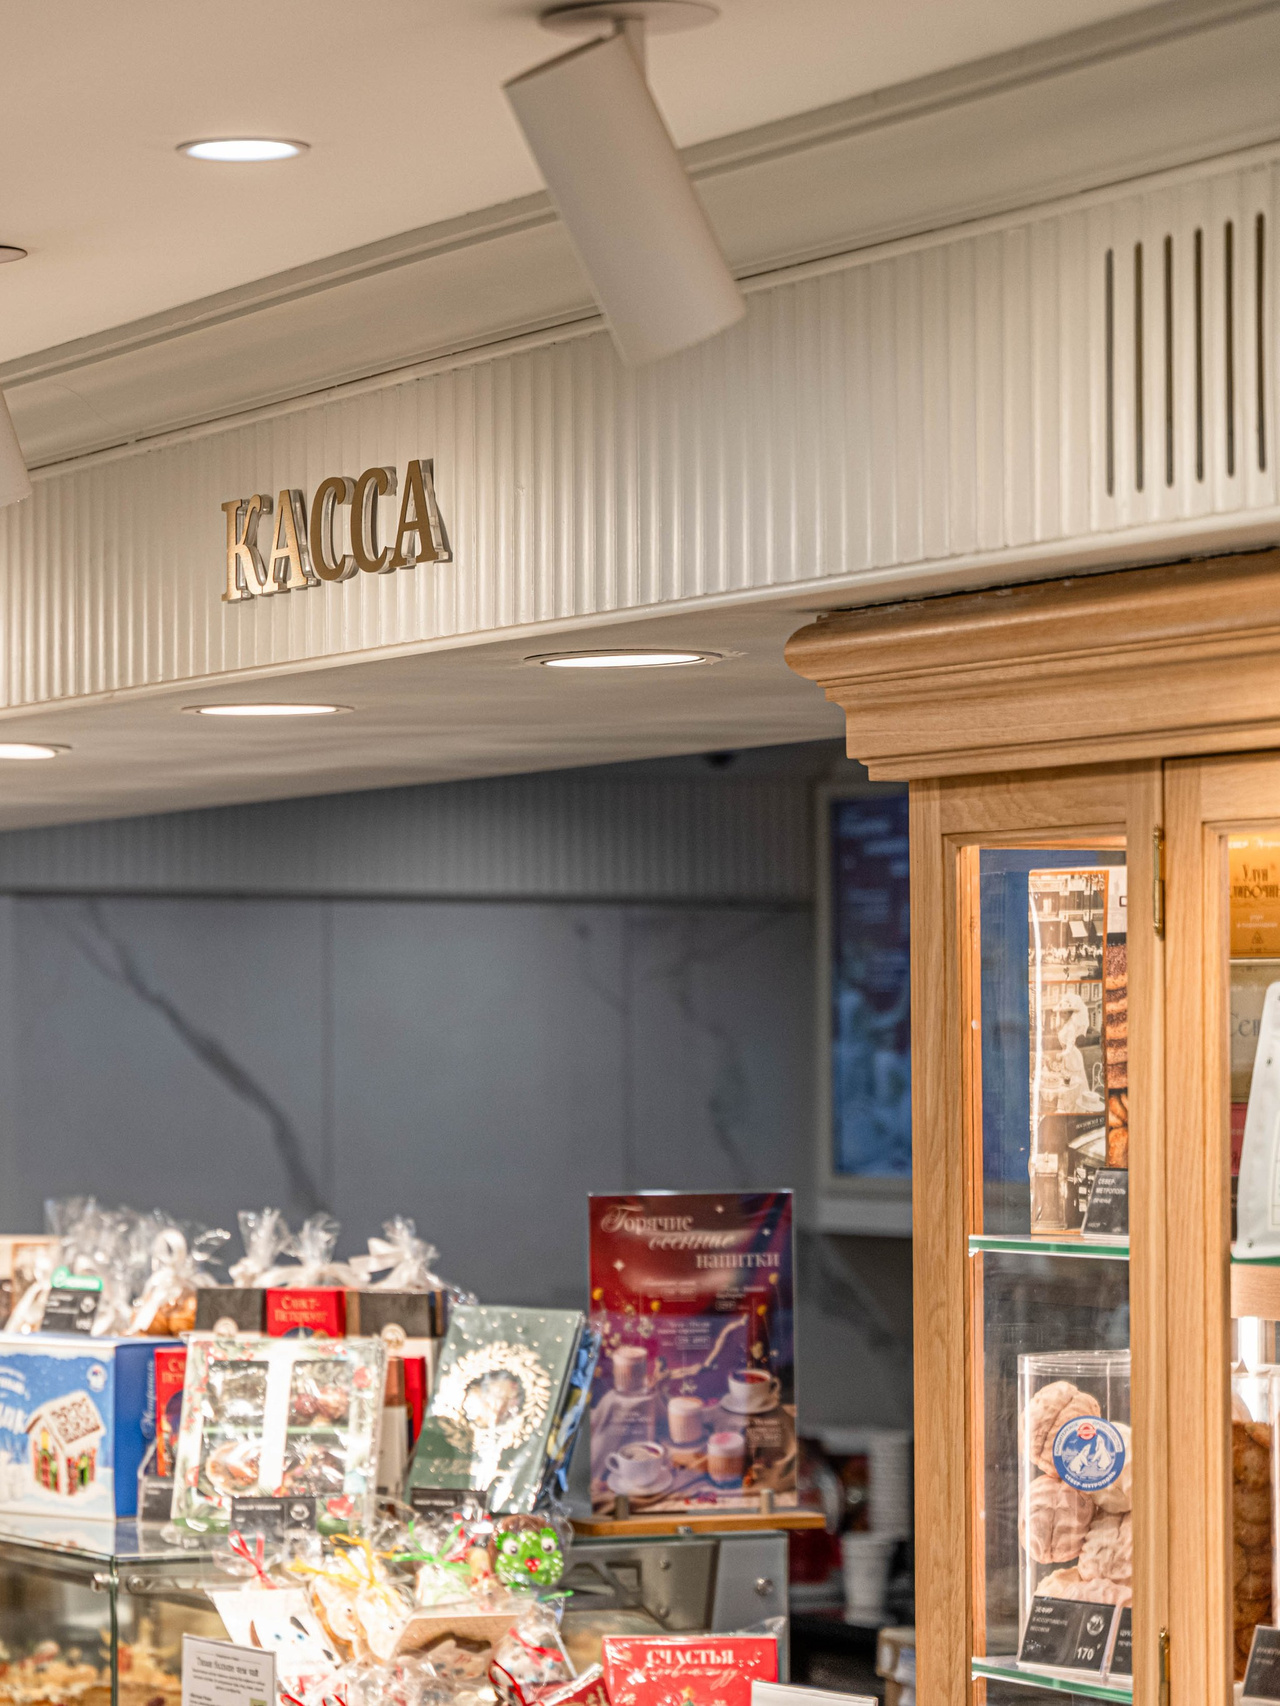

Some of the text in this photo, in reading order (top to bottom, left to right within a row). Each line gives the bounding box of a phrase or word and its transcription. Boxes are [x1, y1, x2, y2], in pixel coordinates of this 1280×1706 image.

[221, 458, 452, 602] КАССА
[600, 1204, 694, 1235] Горячие
[695, 1252, 780, 1269] напитки
[646, 1650, 734, 1666] СЧАСТЬЯ
[1077, 1647, 1095, 1661] 170
